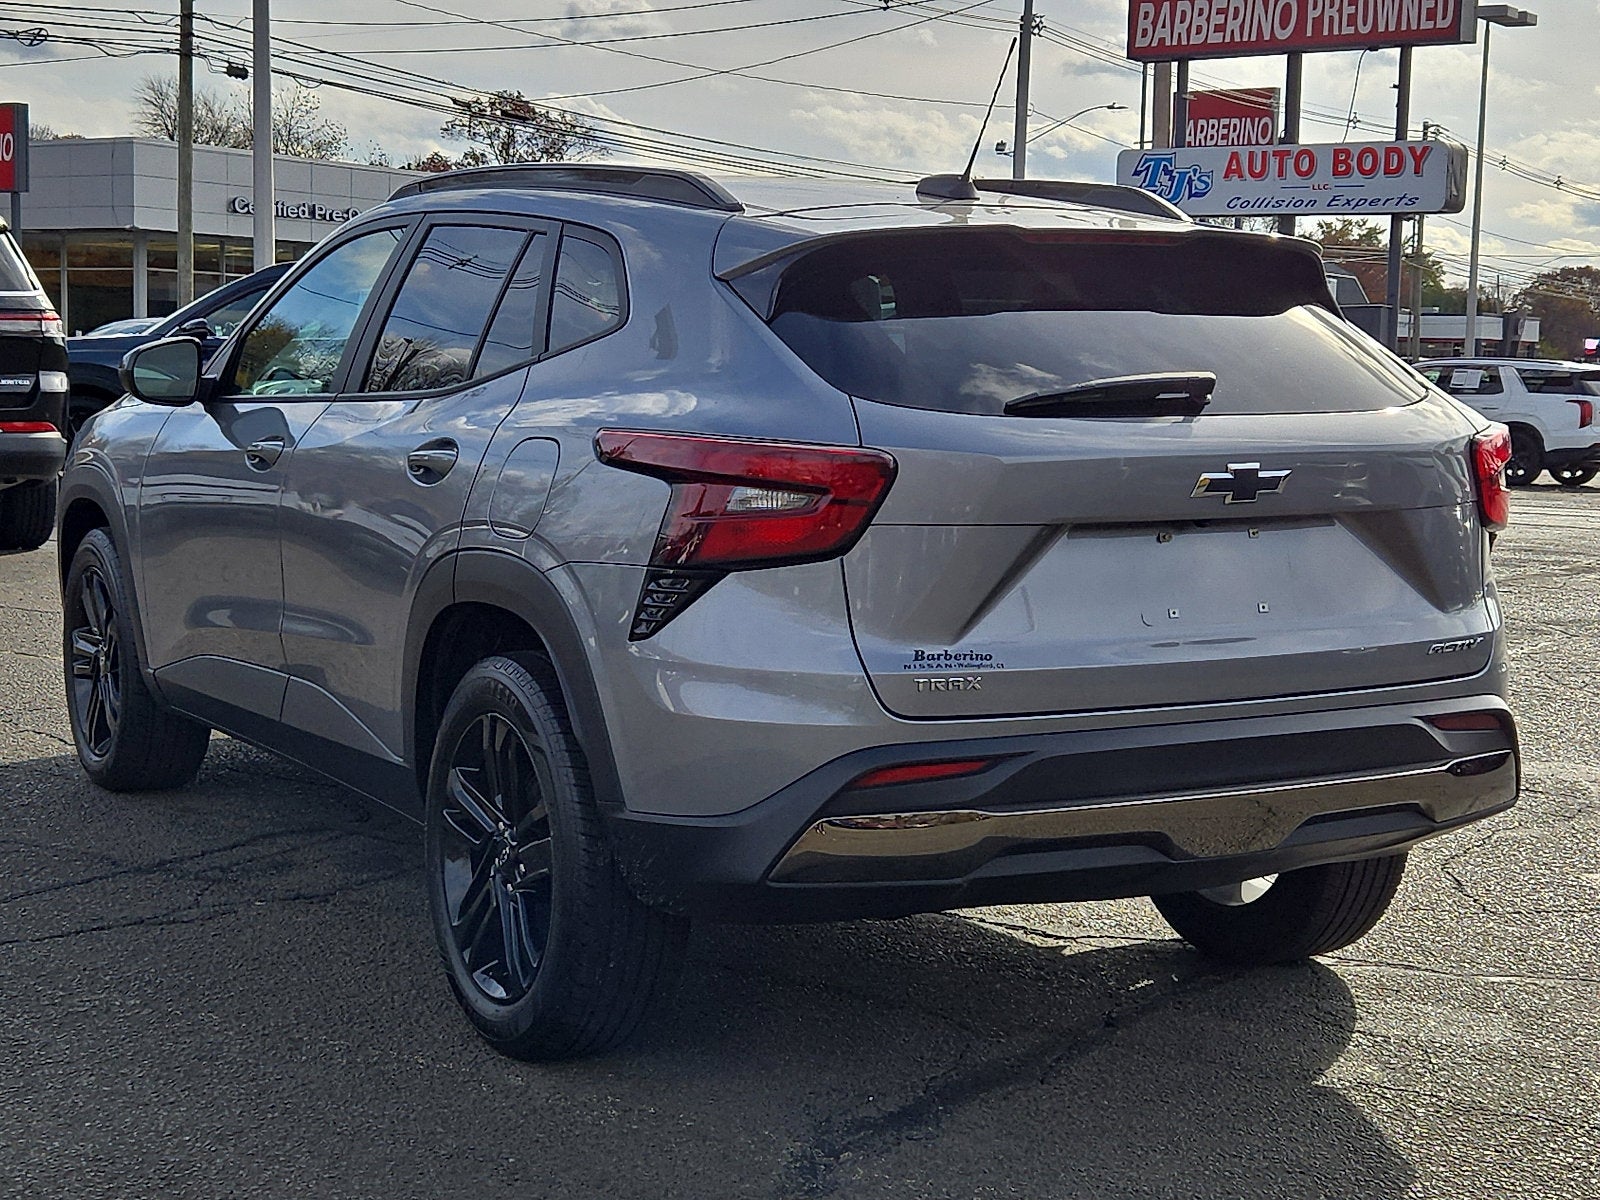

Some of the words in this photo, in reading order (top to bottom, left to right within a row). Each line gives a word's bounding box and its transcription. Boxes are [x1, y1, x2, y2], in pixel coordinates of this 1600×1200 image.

[1134, 0, 1298, 47] BARBERINO
[1306, 0, 1456, 37] PREOWNED
[1186, 117, 1272, 147] ARBERINO
[1223, 148, 1317, 180] AUTO
[1331, 146, 1432, 179] BODY
[1226, 196, 1318, 210] Collision
[1326, 193, 1420, 211] Experts
[912, 649, 994, 662] Barberino
[914, 676, 982, 692] TRAX
